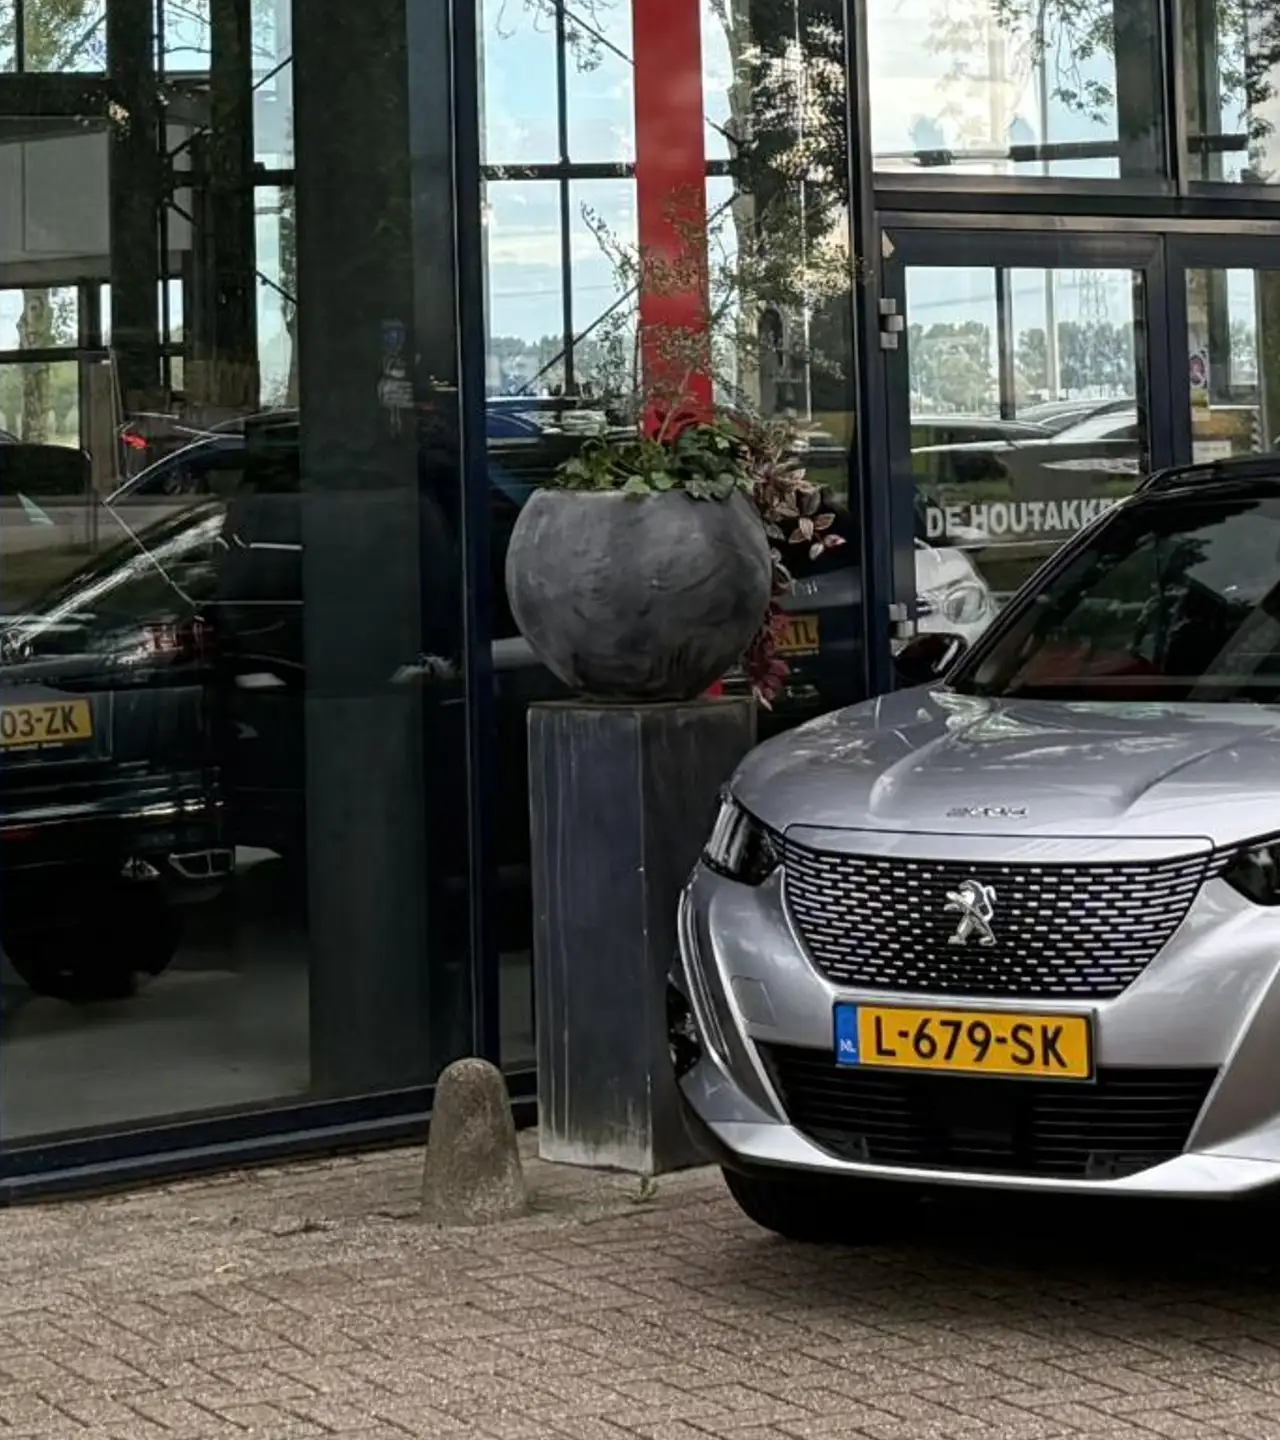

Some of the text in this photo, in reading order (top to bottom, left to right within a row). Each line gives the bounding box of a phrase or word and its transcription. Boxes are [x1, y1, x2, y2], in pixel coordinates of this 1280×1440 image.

[925, 505, 962, 538] DE
[839, 1014, 1068, 1069] NL L-679-SK
